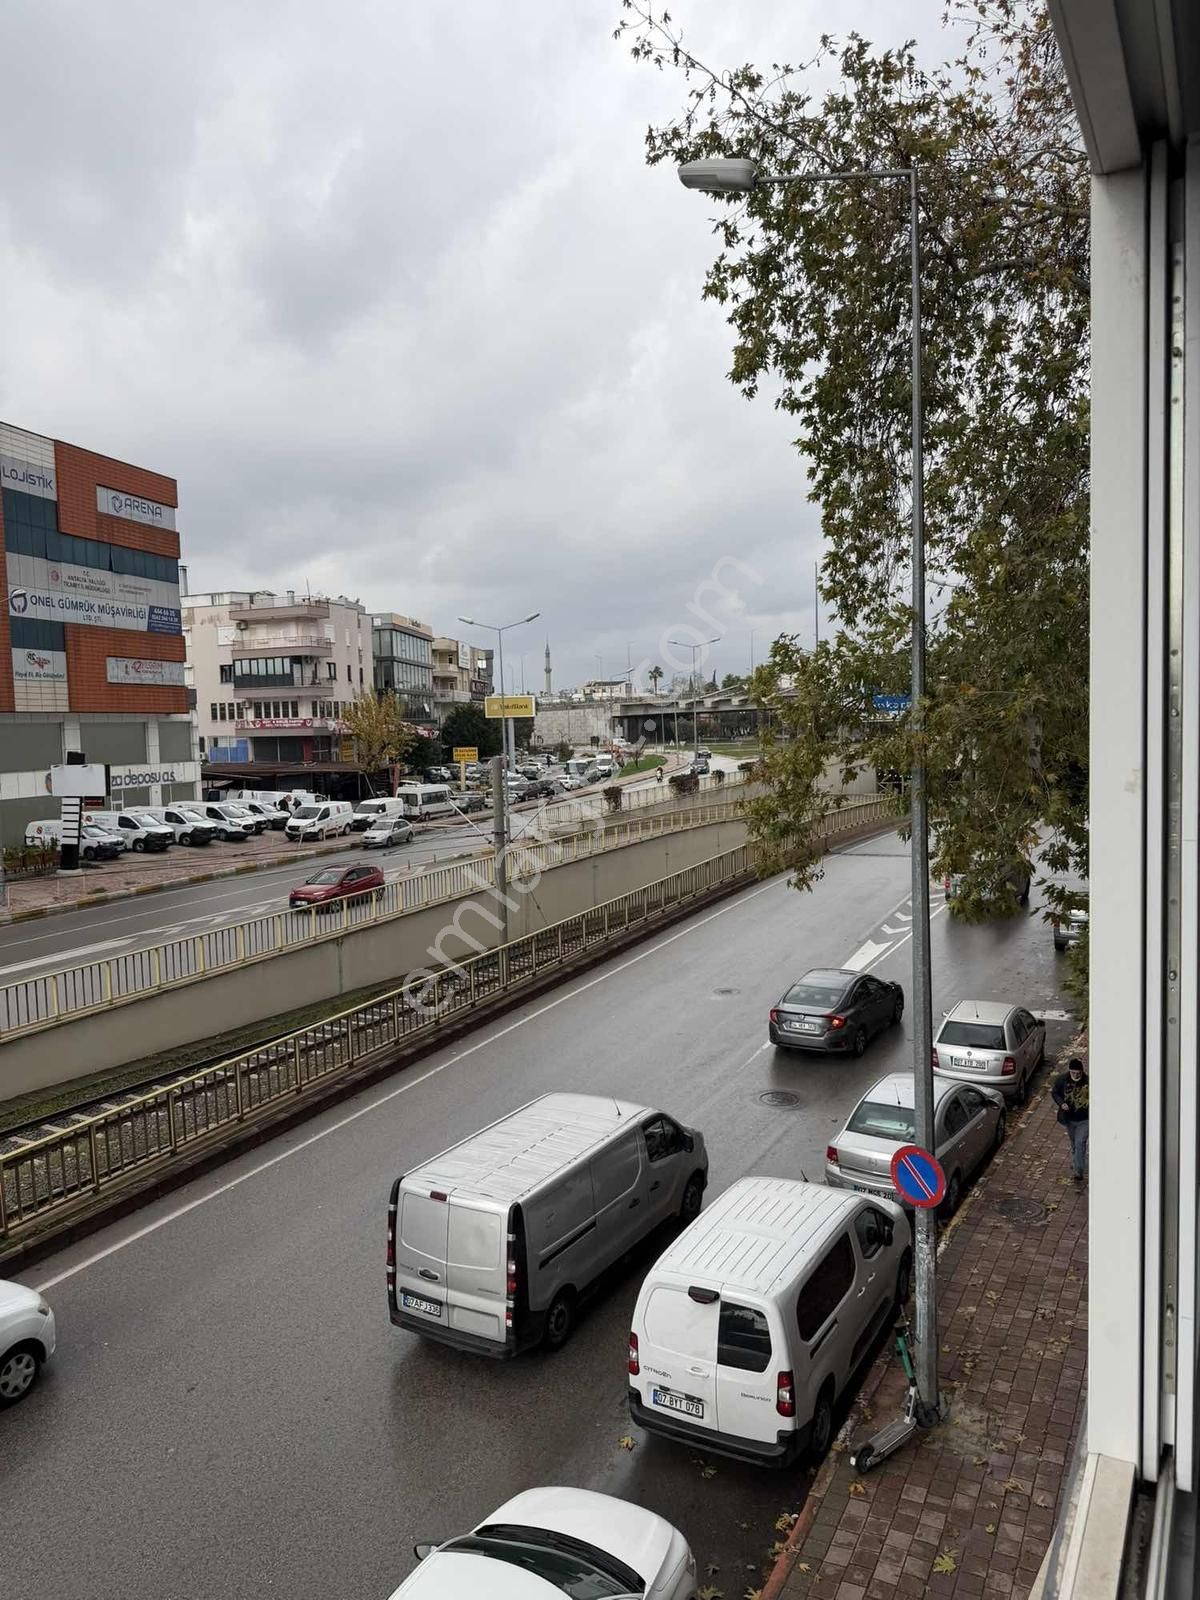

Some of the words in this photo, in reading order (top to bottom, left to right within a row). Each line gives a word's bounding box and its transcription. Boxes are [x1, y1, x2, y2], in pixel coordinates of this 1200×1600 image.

[124, 497, 162, 518] ARENA
[30, 595, 56, 608] ONEL
[58, 597, 96, 614] GÜMRÜK
[98, 603, 147, 620] MÜŞAVİRLİĞİ
[124, 768, 161, 787] deposu
[657, 1392, 668, 1403] 07
[669, 1396, 683, 1410] BYT
[685, 1401, 701, 1415] 078
